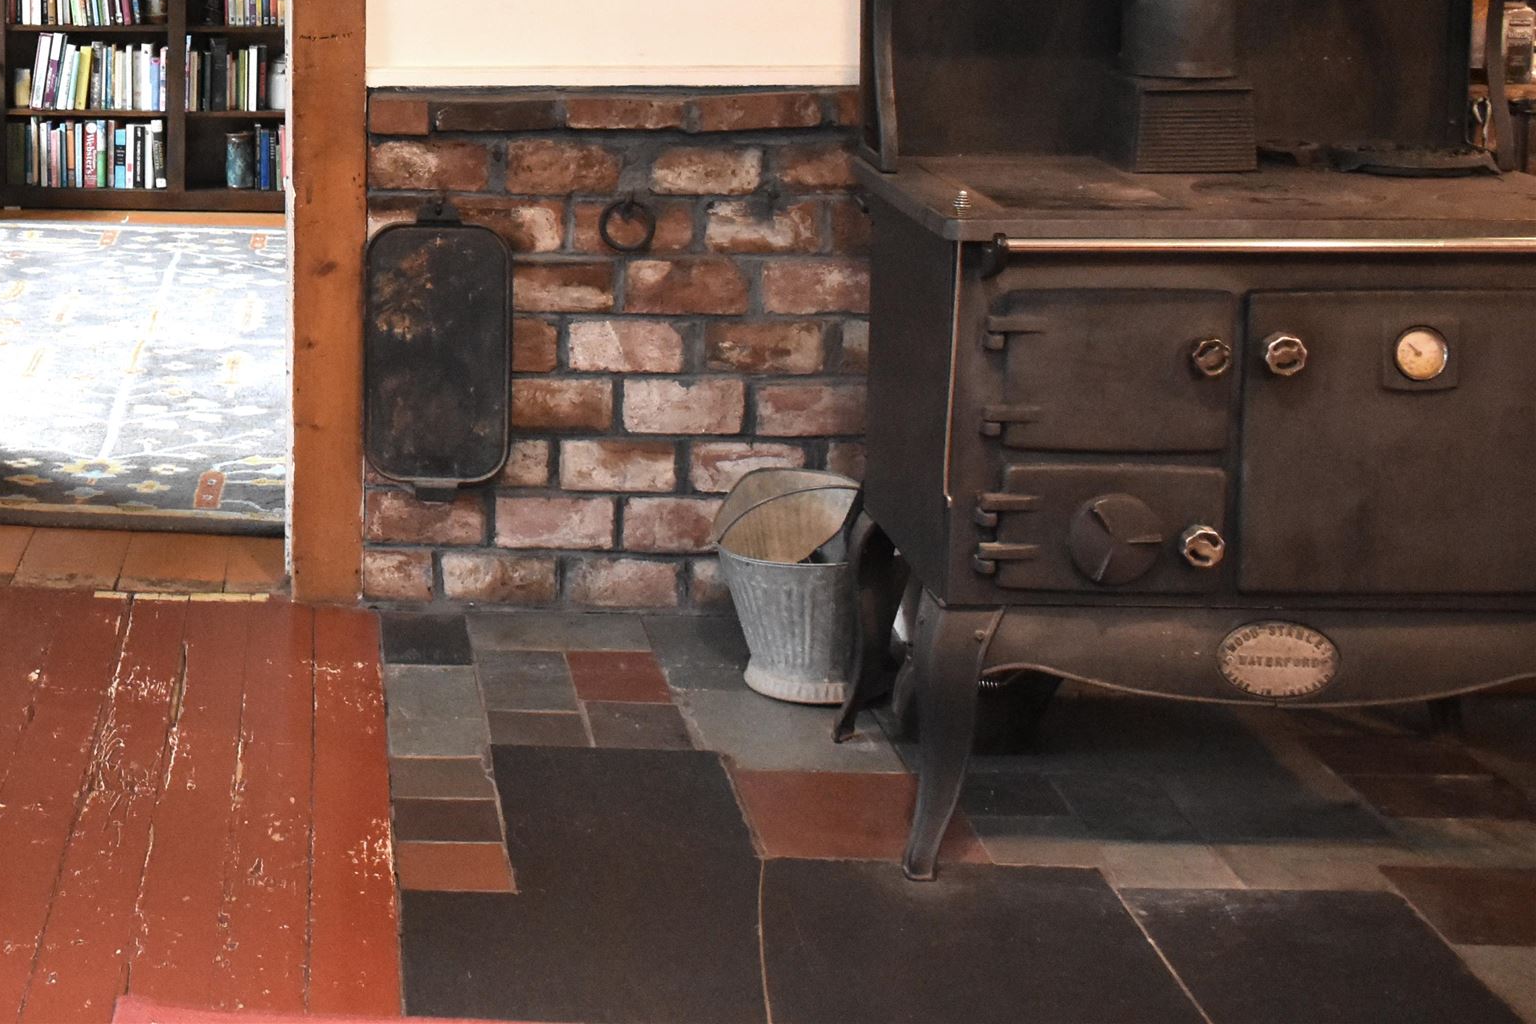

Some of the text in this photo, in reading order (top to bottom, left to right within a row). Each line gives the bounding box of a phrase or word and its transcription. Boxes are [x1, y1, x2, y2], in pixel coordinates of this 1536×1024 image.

[86, 134, 95, 177] Webster's
[1226, 627, 1260, 653] WOOD
[1238, 655, 1318, 668] WATERFORD
